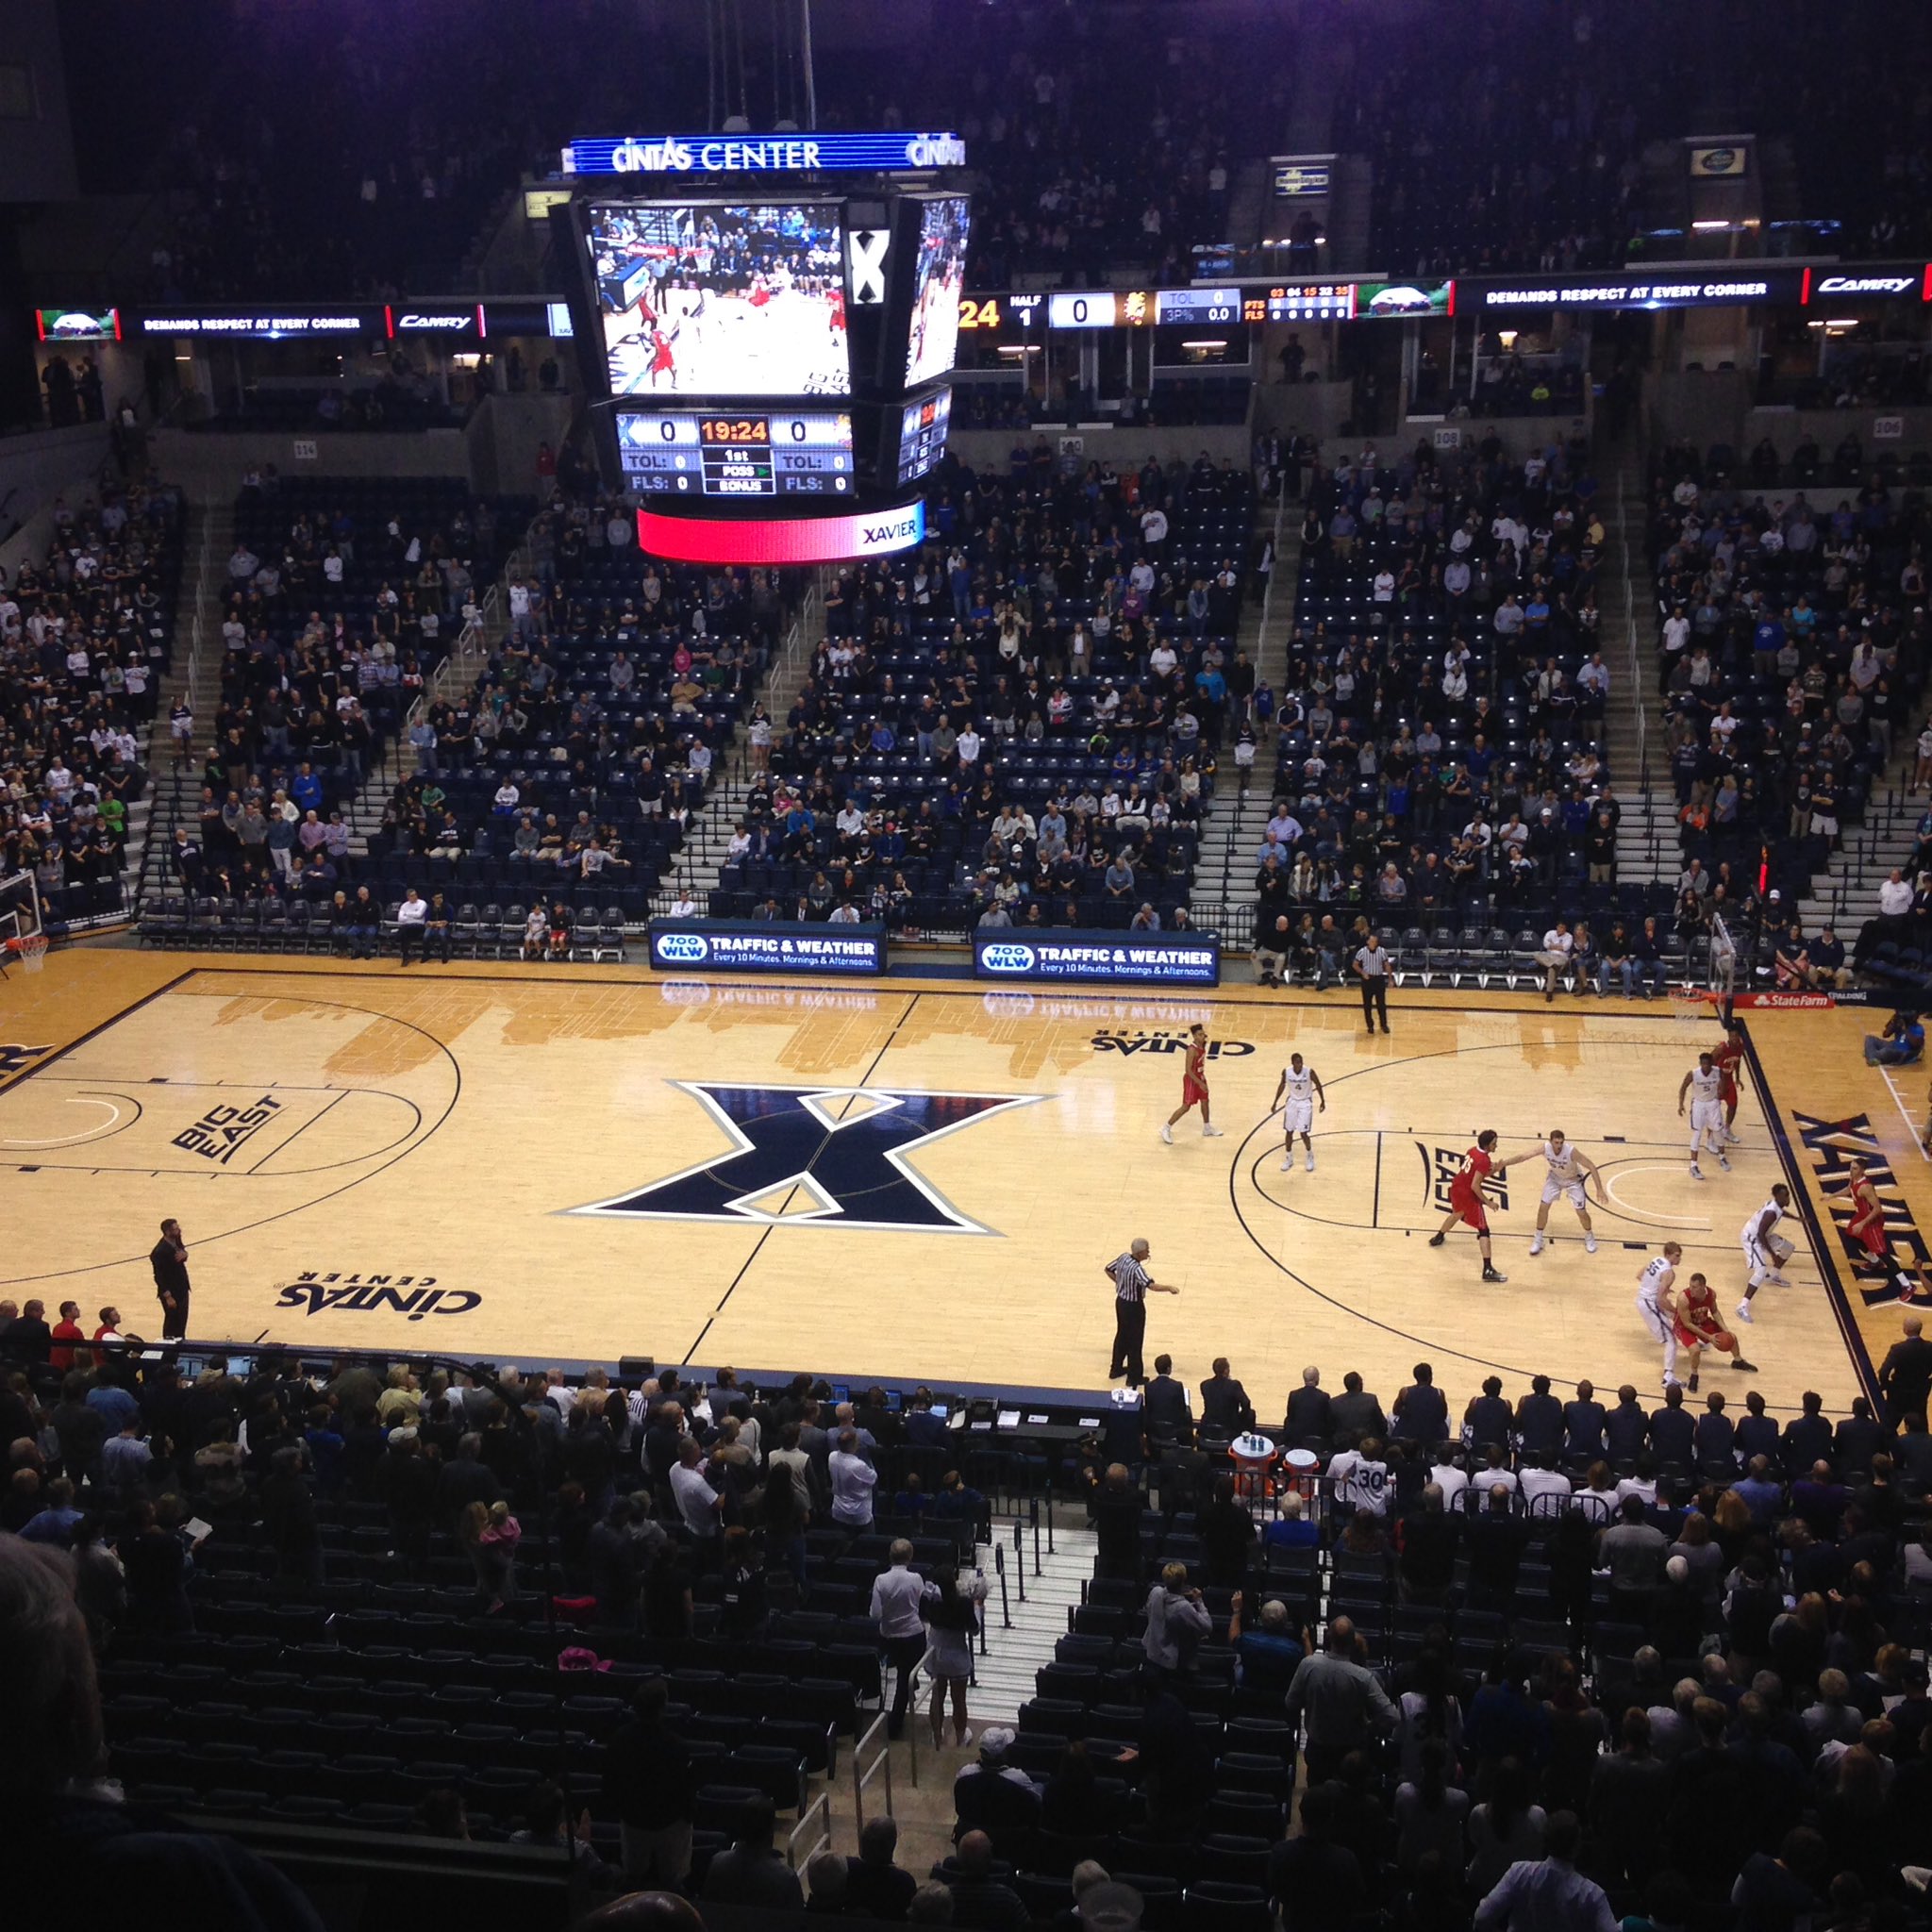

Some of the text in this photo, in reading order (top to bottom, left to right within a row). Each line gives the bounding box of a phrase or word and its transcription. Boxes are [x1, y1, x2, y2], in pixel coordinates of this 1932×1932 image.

[701, 142, 821, 170] CENTER
[1170, 291, 1224, 305] TOL 0
[1303, 287, 1317, 296] 15
[1487, 283, 1767, 304] DEMANDS RESPECT AT EVERY CORNER
[1009, 295, 1041, 308] HALF
[1244, 300, 1265, 309] PTS
[1020, 308, 1031, 326] 1
[1073, 299, 1088, 323] 0
[1167, 308, 1229, 322] 3P% 0.0
[1244, 310, 1265, 320] FLS
[143, 318, 360, 330] DEMANDS RESPECT AT EVERY CORNER
[660, 421, 675, 441] 0
[702, 421, 768, 441] 19:24
[791, 421, 806, 441] 0
[1061, 441, 1081, 453] 10
[628, 455, 686, 469] TOL: 0
[724, 449, 749, 461] 1st
[783, 455, 845, 470] TOL: 0
[723, 466, 755, 477] POSS
[631, 476, 689, 490] FLS: 0
[720, 481, 761, 491] BONUS
[785, 476, 847, 491] FLS: 0
[862, 519, 917, 544] XAVIER
[664, 947, 704, 957] WLW
[710, 938, 874, 955] TRAFFIC & WEATHER
[992, 946, 1025, 955] 700
[713, 953, 736, 963] Every
[738, 953, 748, 961] 10
[783, 955, 819, 965] Mornings
[987, 957, 1030, 967] WLW
[1038, 947, 1212, 964] TRAFFIC & WEATHER
[1041, 963, 1063, 974] Every
[1066, 963, 1076, 972] 10
[1115, 964, 1152, 975] Mornings
[1154, 966, 1161, 974] &
[1828, 991, 1867, 1001] SPALDING
[1095, 1029, 1189, 1038] ENTER
[171, 1104, 241, 1150] BIG
[195, 1094, 282, 1158] EAST
[297, 1271, 437, 1287] CENTER
[1359, 1469, 1383, 1491] 30
